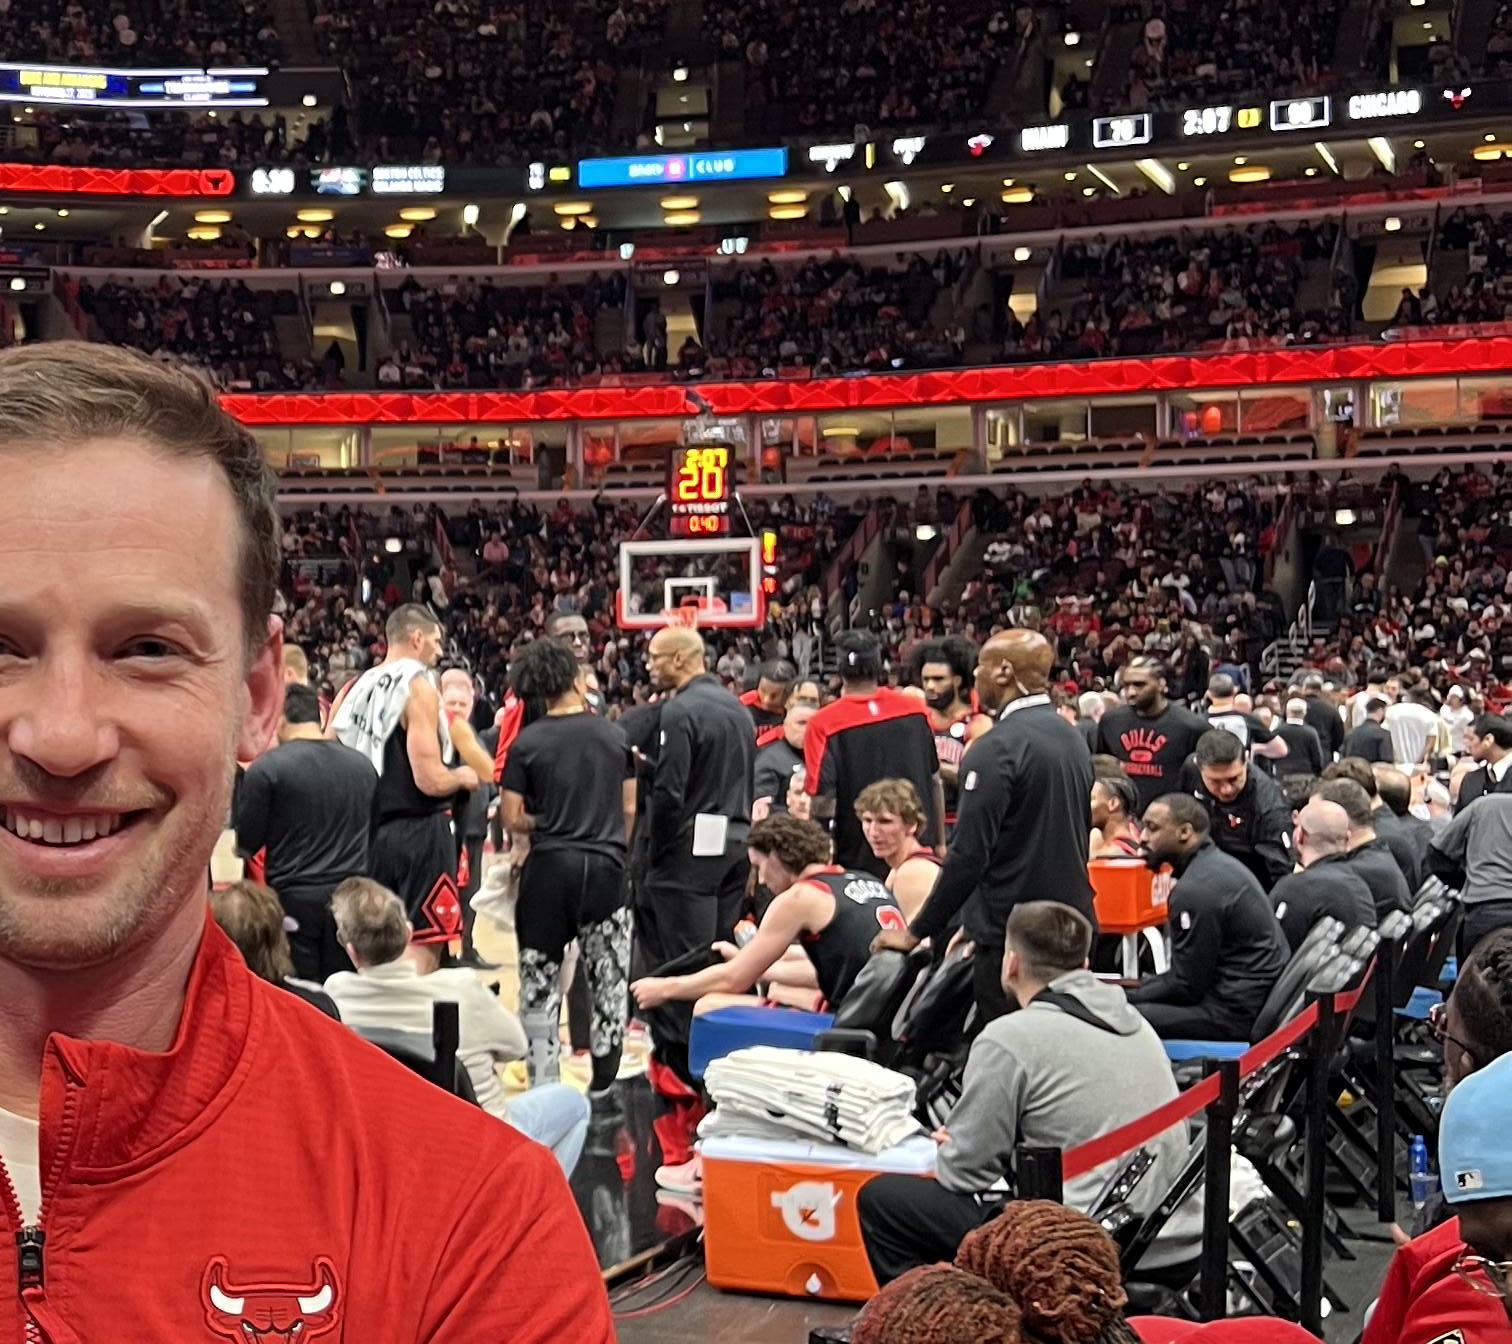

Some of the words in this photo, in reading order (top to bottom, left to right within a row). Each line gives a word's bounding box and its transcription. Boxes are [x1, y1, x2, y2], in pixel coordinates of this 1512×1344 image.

[1183, 106, 1232, 136] 2:07
[1349, 89, 1422, 121] CHICAGO
[685, 447, 729, 469] 2:07
[679, 465, 723, 501] 20
[1120, 727, 1167, 752] BULLS
